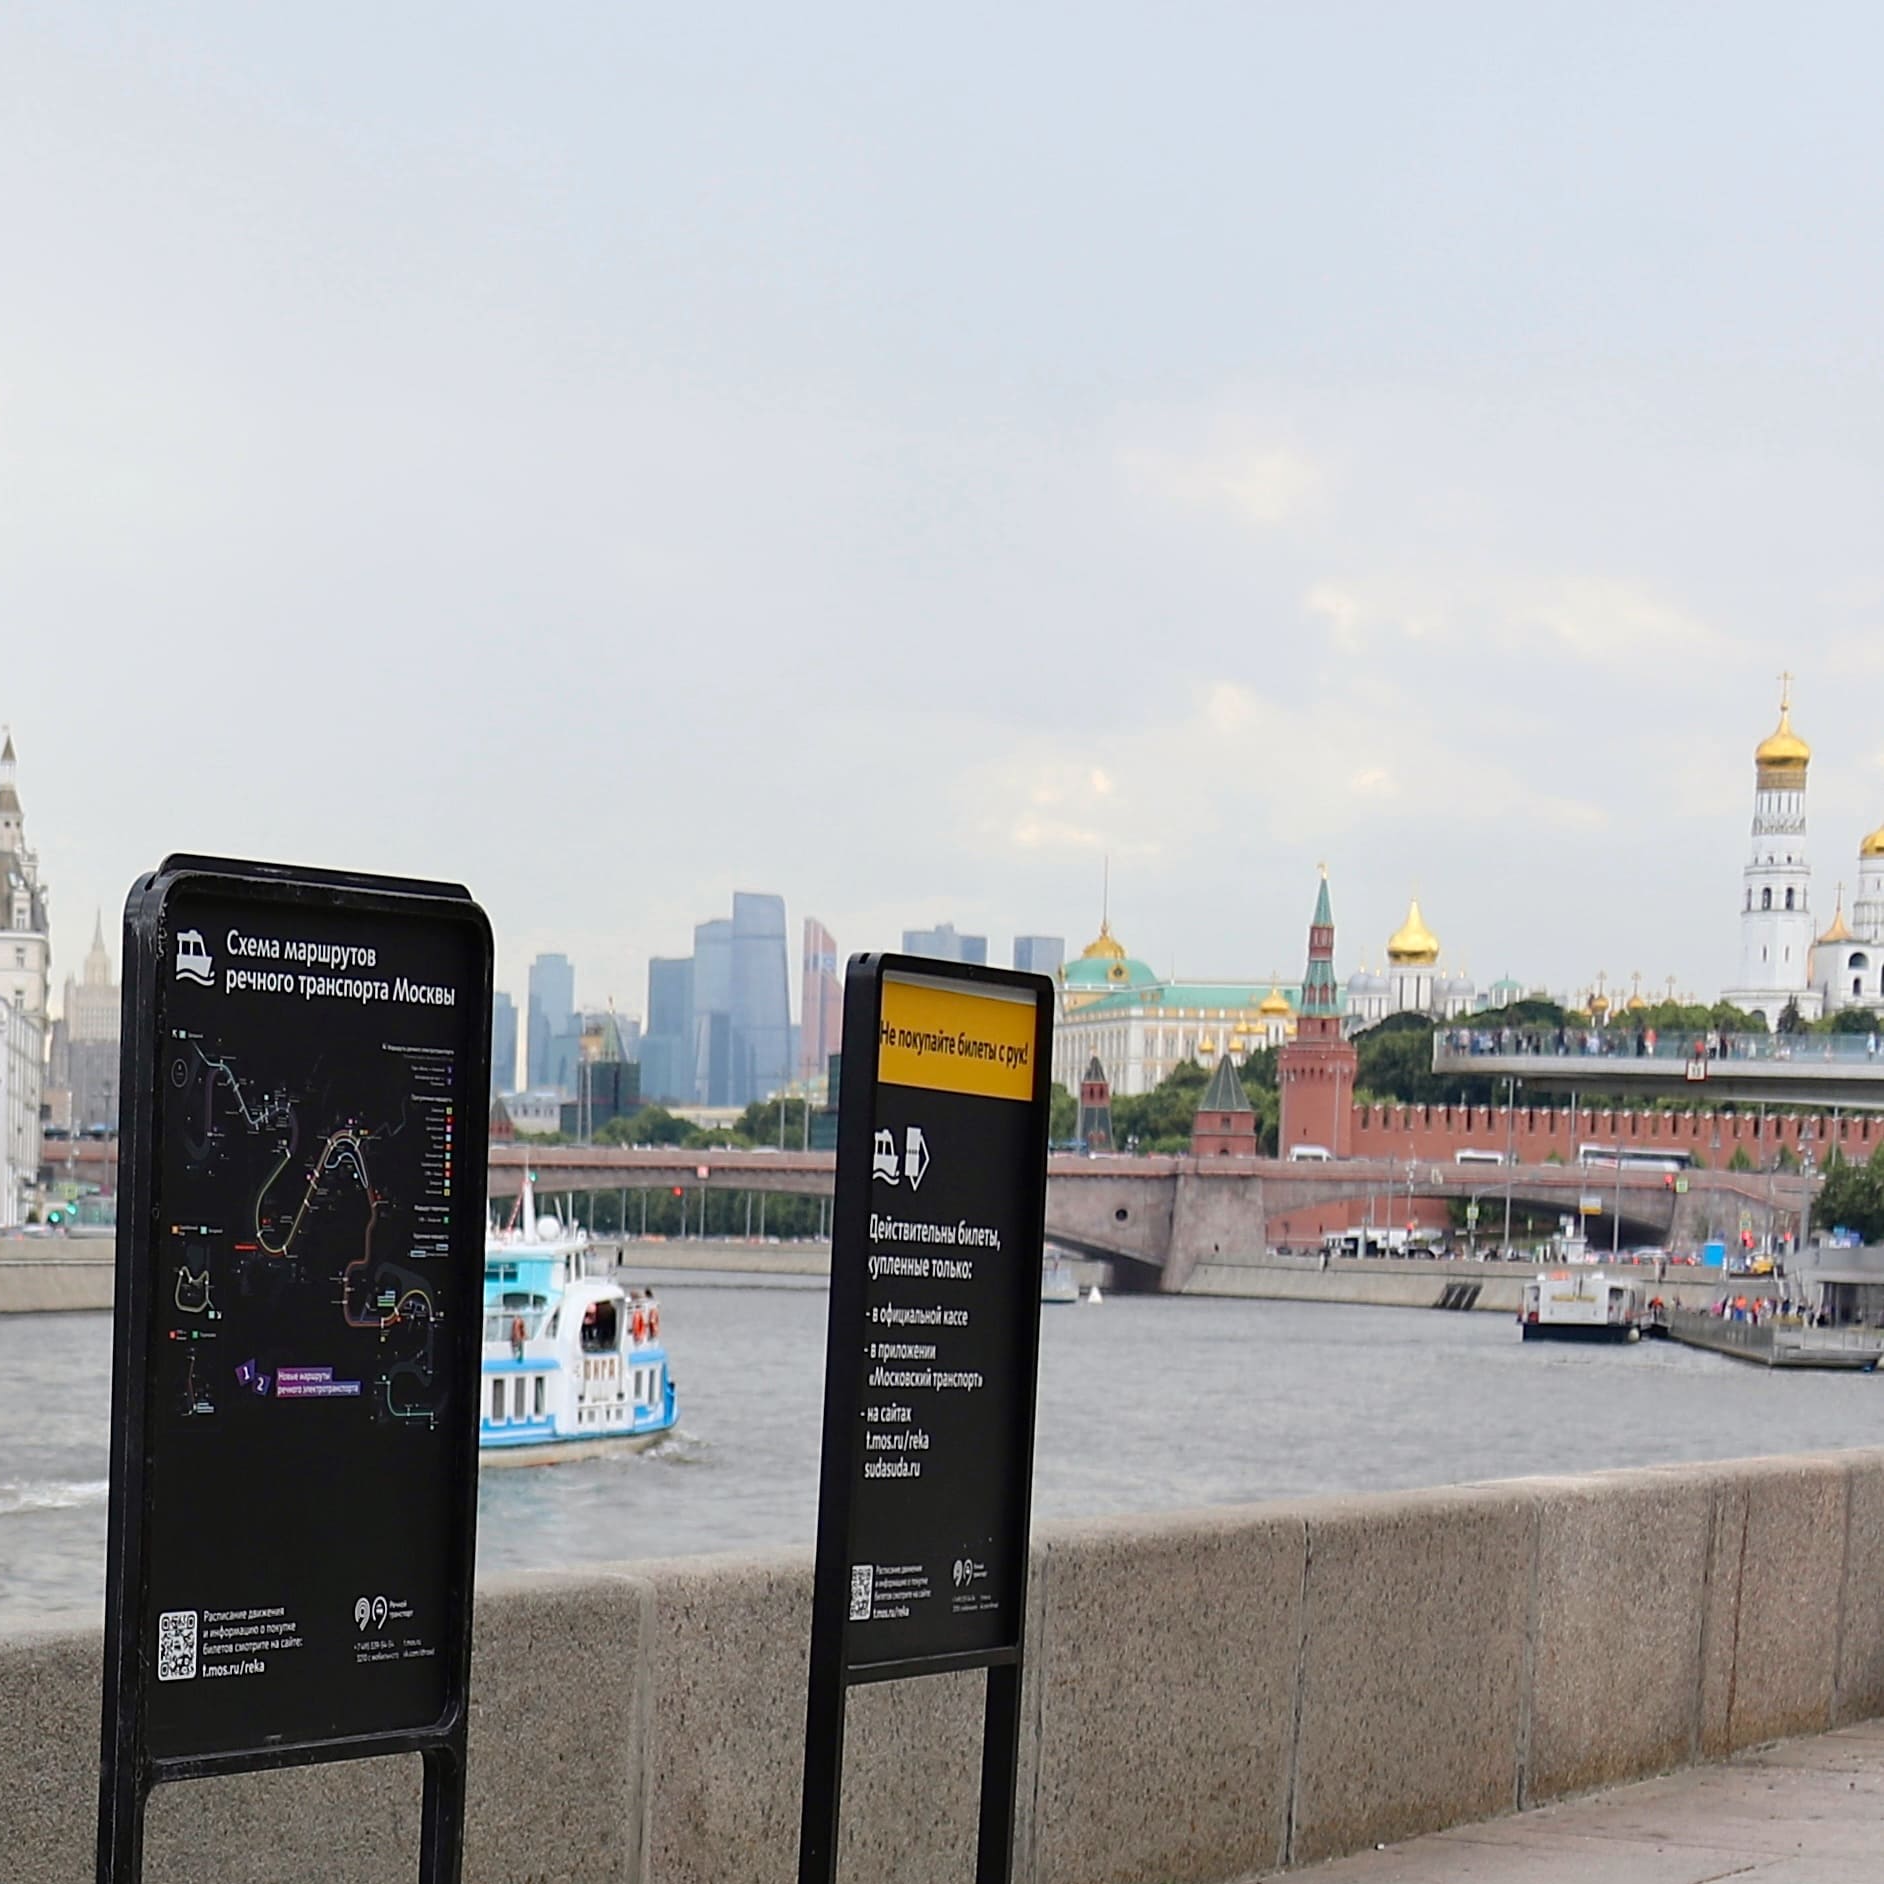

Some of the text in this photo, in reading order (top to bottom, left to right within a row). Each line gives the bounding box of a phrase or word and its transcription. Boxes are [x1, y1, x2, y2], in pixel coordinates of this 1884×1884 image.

[226, 929, 377, 971] Схема маршрутов
[225, 968, 455, 1006] речного транспорта Москвы
[880, 1019, 1029, 1070] Не покупайте билеты с рук!
[869, 1213, 1001, 1252] Действительны билеты,
[932, 1258, 973, 1280] только:
[880, 1301, 942, 1328] официальной
[943, 1309, 969, 1326] кассе
[878, 1343, 937, 1364] приложении
[243, 1366, 250, 1380] 1
[256, 1376, 264, 1392] 2
[869, 1365, 983, 1393] «Московский транспорт»
[867, 1402, 912, 1423] на сайтах
[866, 1427, 929, 1452] t.mos.ru/reka
[864, 1456, 921, 1479] sudasuda.ru
[203, 1607, 285, 1623] Расписание движения
[209, 1624, 259, 1640] информацию
[266, 1622, 297, 1636] покупке
[202, 1642, 234, 1656] билетов
[234, 1640, 270, 1654] смотрите
[270, 1639, 279, 1649] на
[202, 1658, 265, 1678] t.mos.ru/reka
